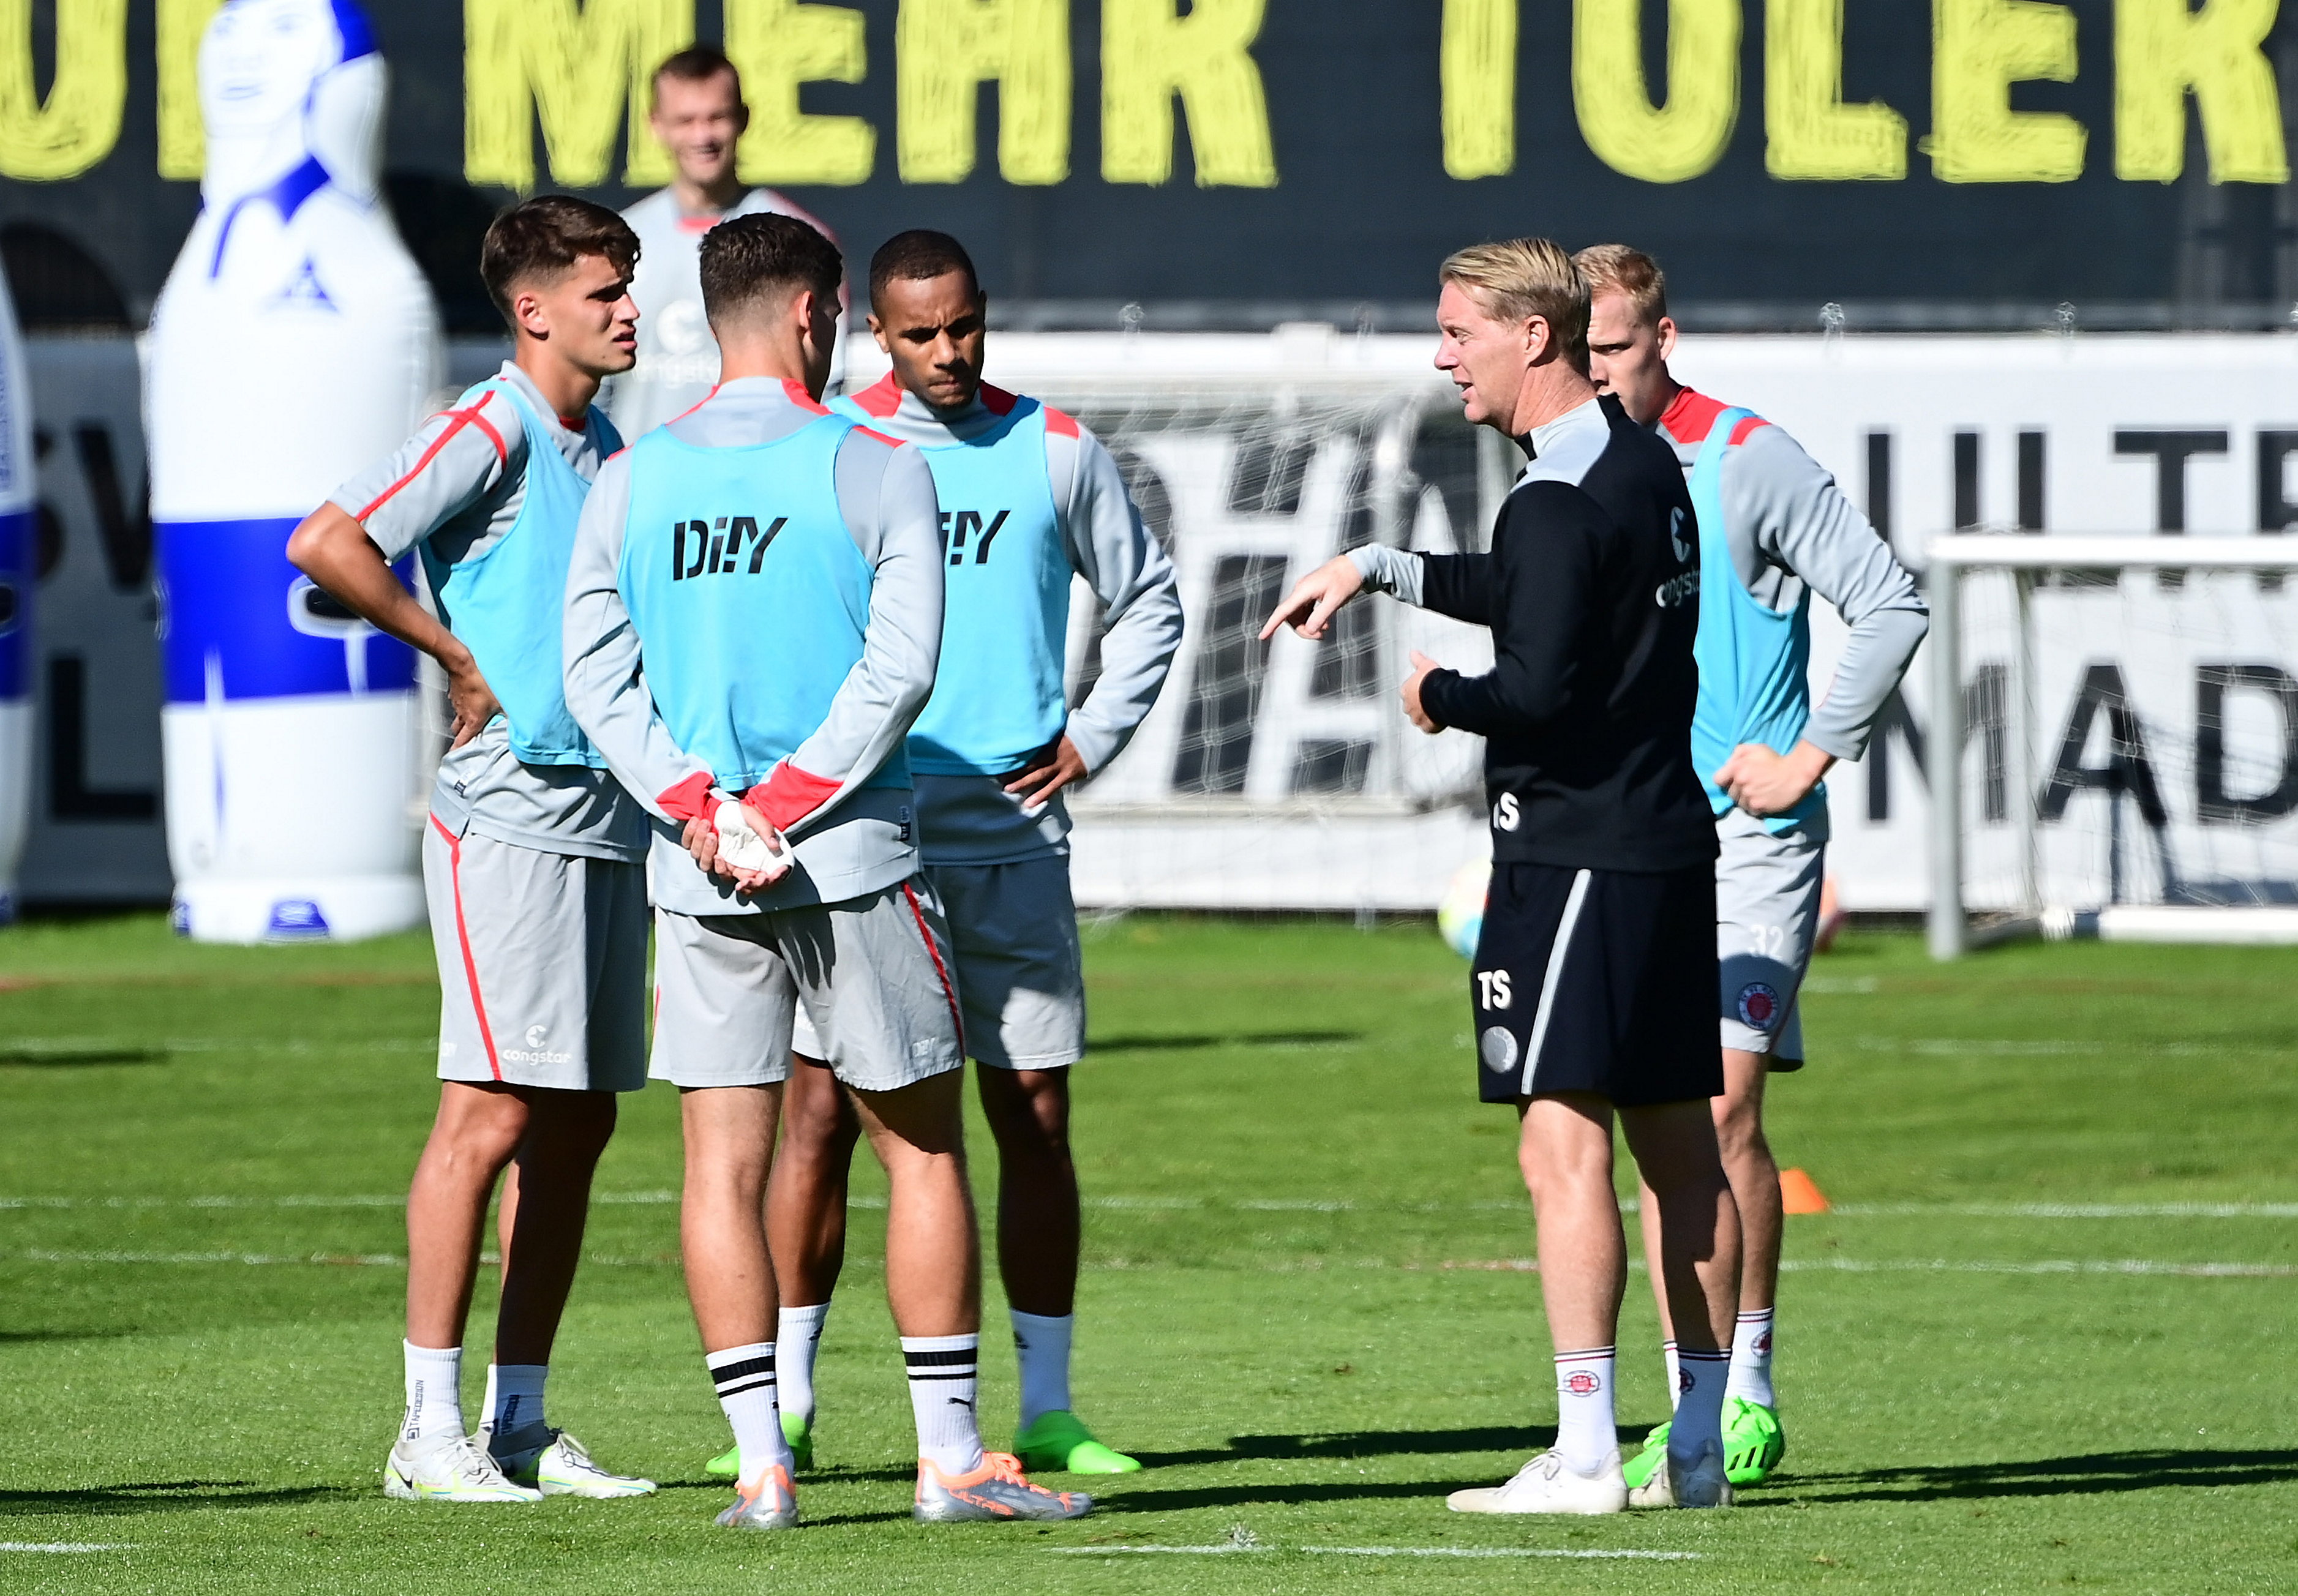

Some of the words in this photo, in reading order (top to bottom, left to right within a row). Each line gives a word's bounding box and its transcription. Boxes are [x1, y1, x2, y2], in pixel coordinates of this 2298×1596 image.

[464, 0, 1279, 187] MEHR
[1748, 924, 1784, 962] 32
[1477, 968, 1512, 1011] TS
[502, 1049, 572, 1066] congstar
